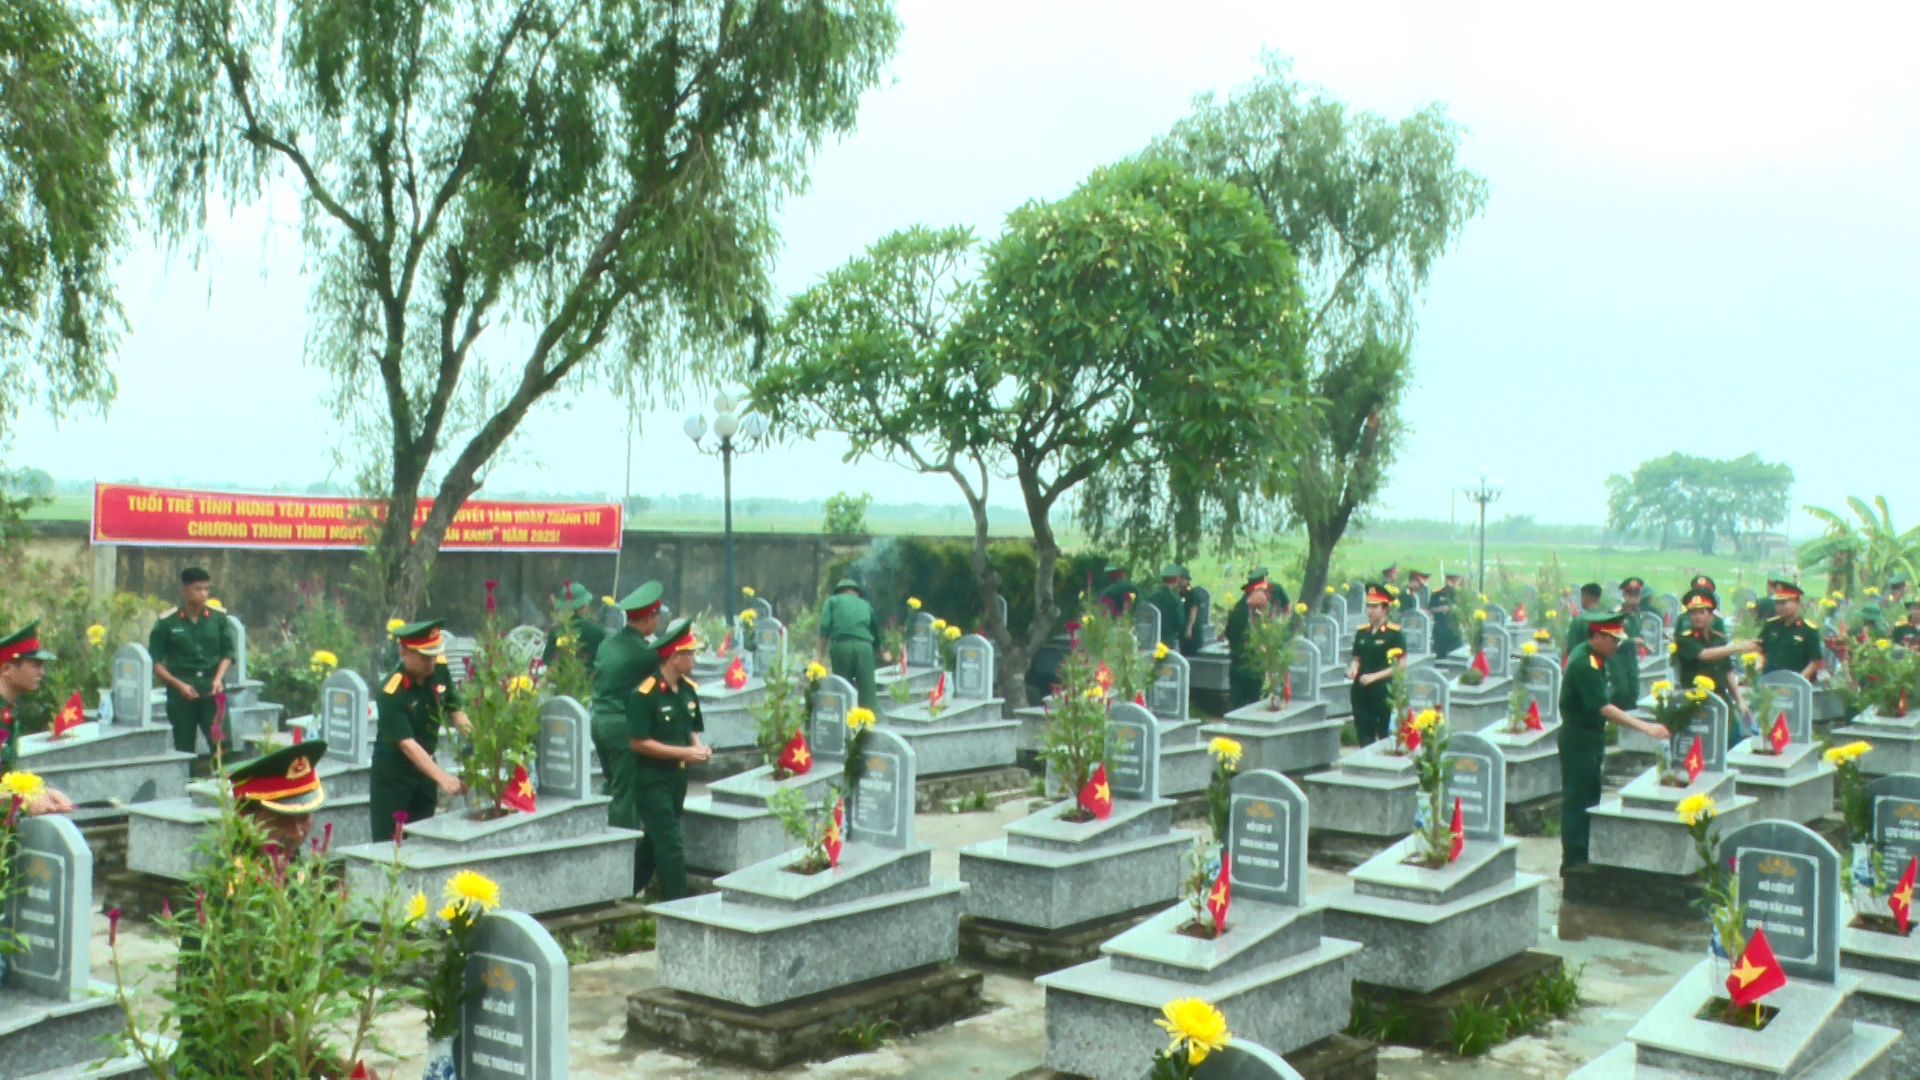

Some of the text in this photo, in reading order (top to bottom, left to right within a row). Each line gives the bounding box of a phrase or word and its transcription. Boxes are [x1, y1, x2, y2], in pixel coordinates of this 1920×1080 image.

[127, 492, 163, 513] TUỔI
[167, 494, 195, 514] TRẺ
[199, 495, 232, 516] TỈNH
[278, 500, 305, 518] YÊN
[308, 502, 344, 519] XUNG
[453, 506, 485, 523] UYẾT
[187, 519, 248, 539] CHƯƠNG
[251, 520, 293, 539] TRÌNH
[295, 520, 327, 539] TÌNH
